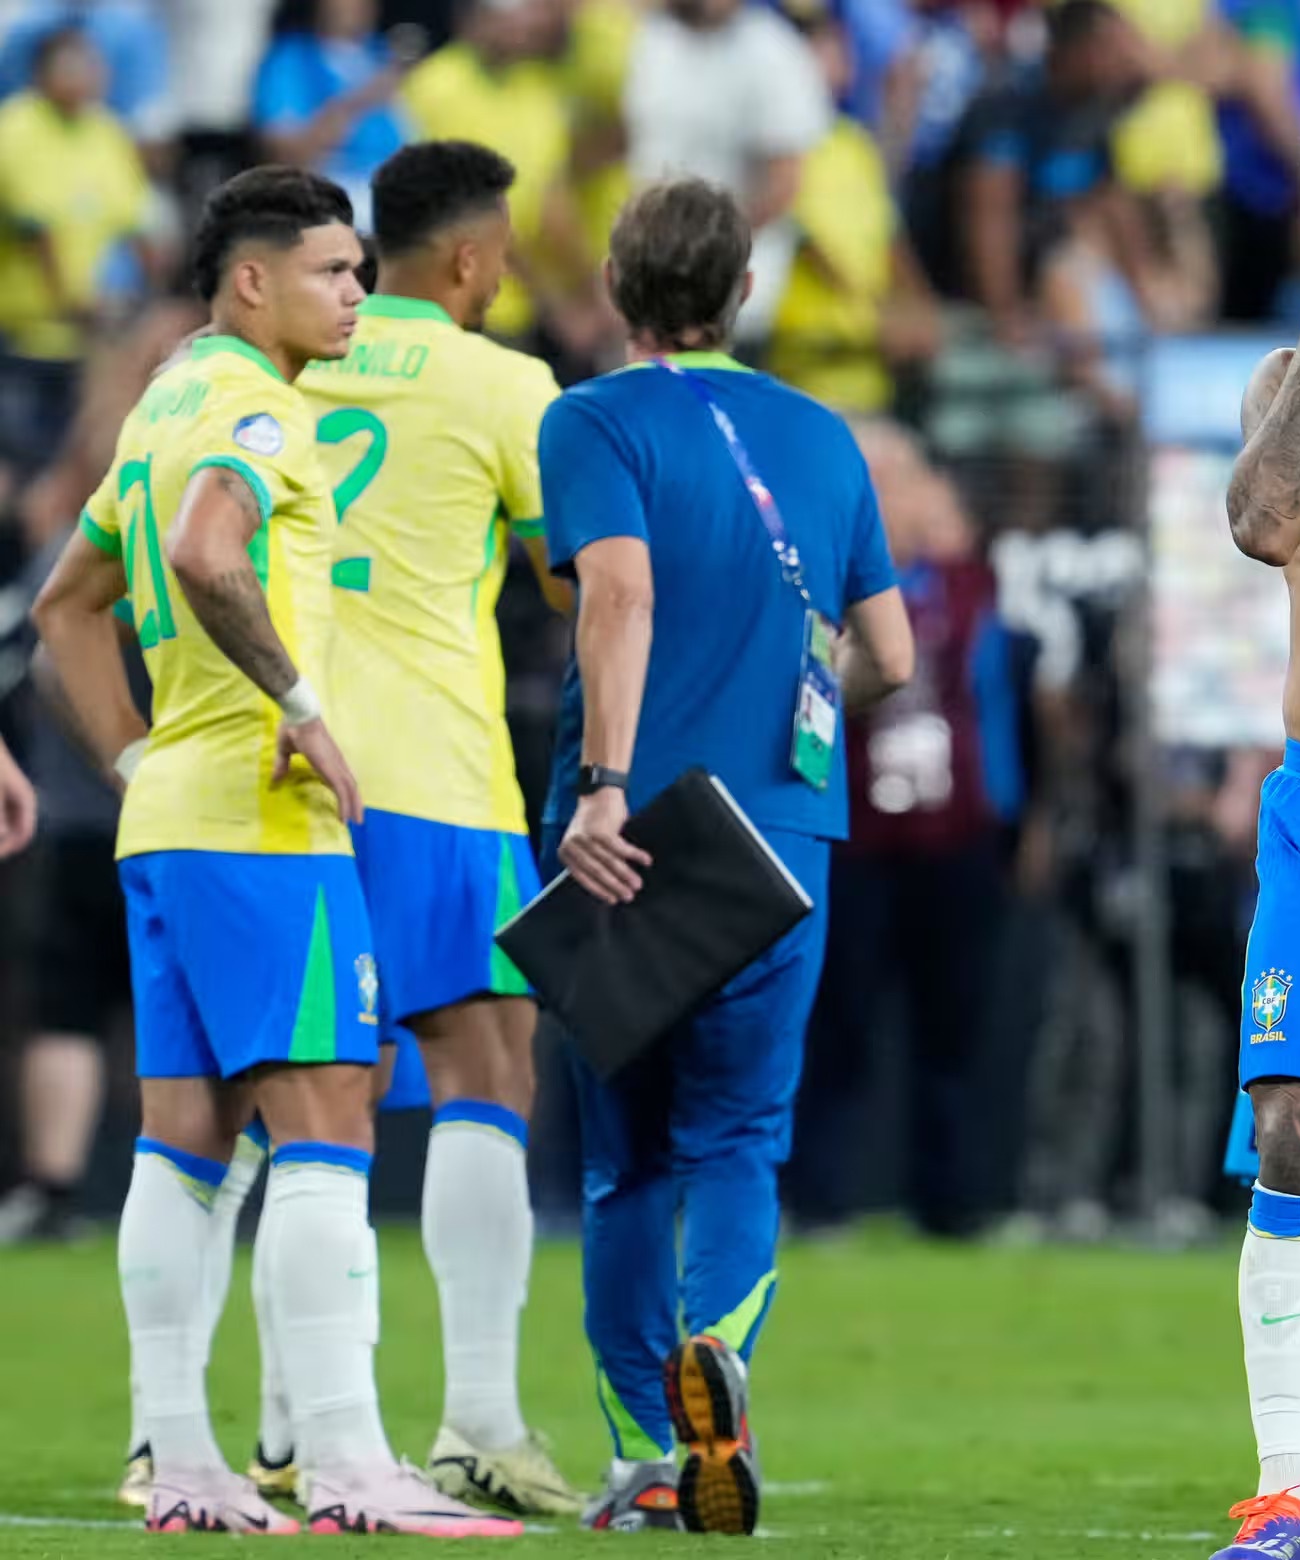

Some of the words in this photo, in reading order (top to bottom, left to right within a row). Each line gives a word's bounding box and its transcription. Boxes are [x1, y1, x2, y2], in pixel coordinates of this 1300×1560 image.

[306, 342, 430, 380] NILO
[316, 406, 388, 592] 2
[1262, 997, 1276, 1005] CBF
[1250, 1031, 1287, 1045] BRASIL
